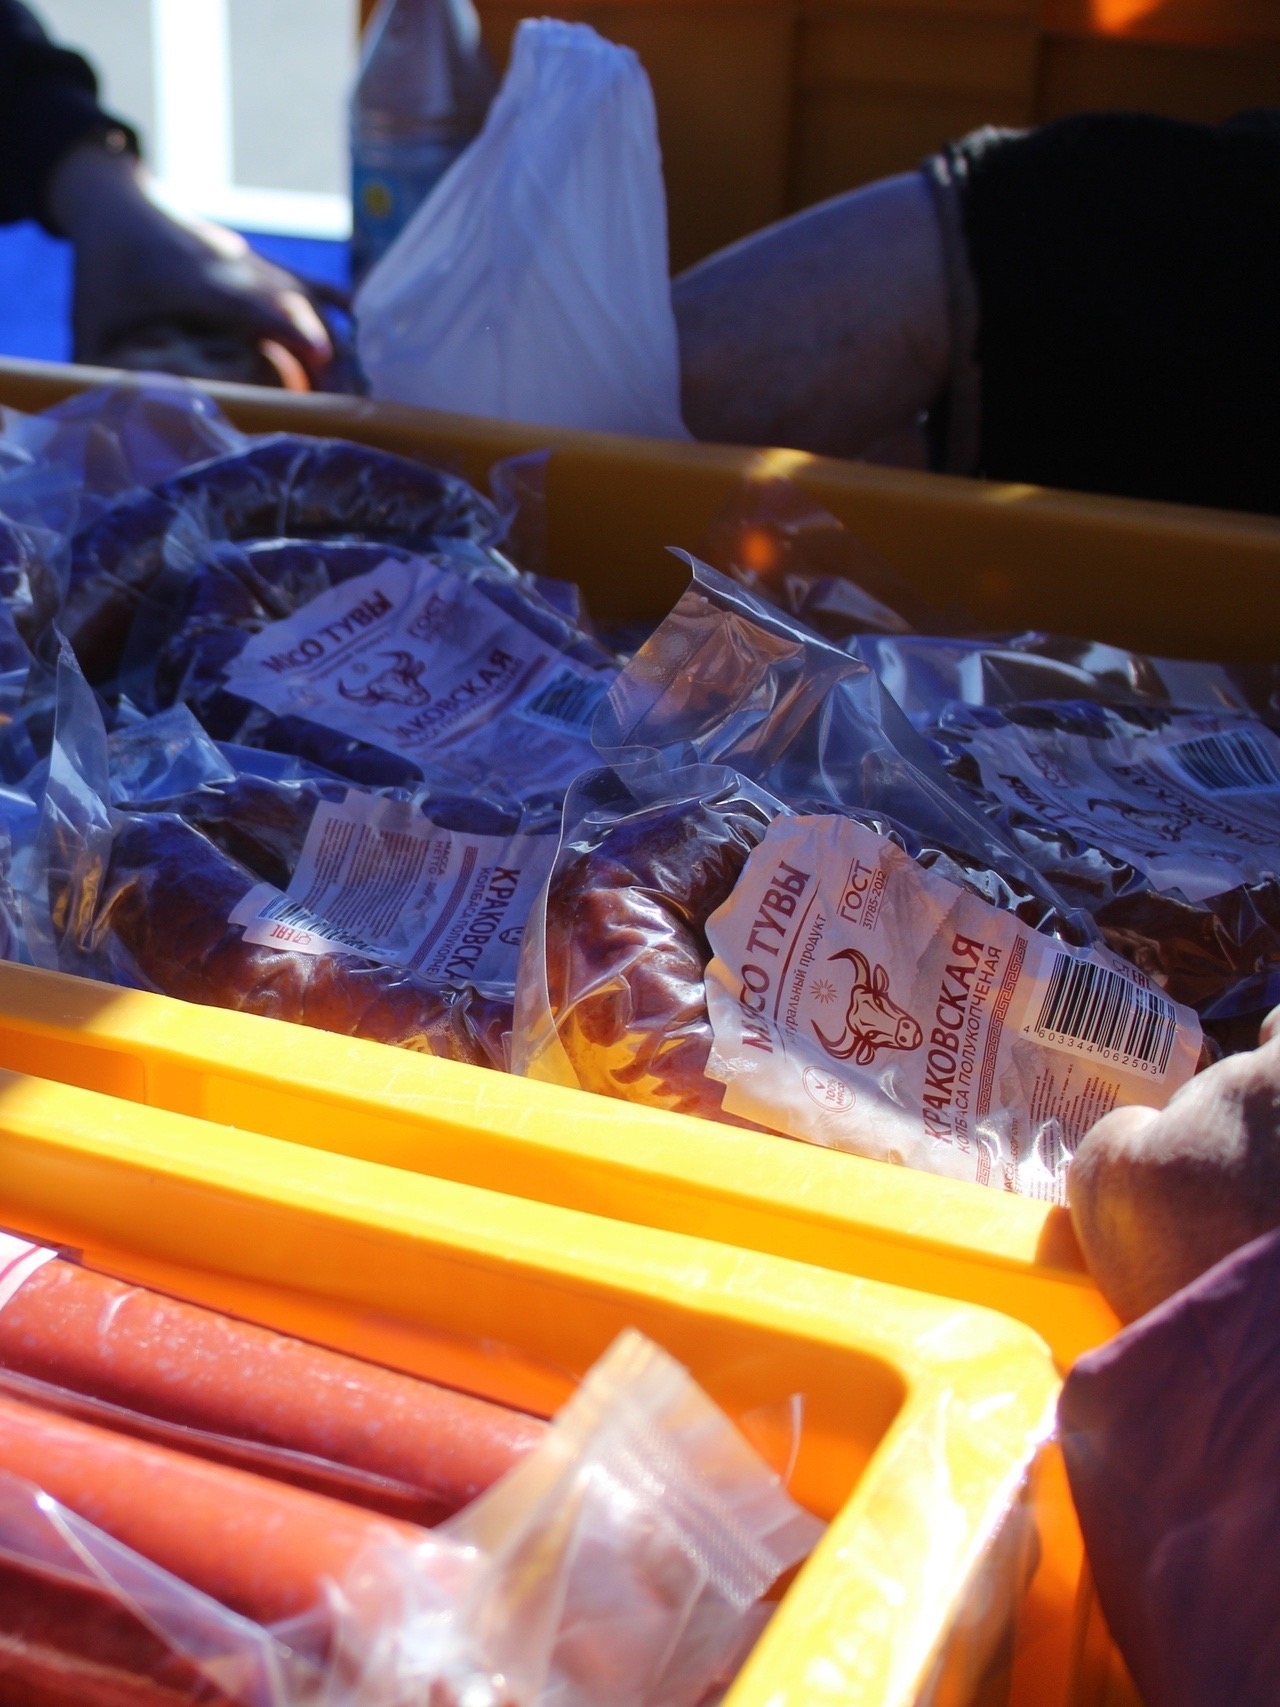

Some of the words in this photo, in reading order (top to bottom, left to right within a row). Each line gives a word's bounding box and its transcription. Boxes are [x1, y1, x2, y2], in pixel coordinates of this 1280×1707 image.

[321, 590, 393, 645] ТУВЫ
[443, 866, 521, 980] КРАКОВСКА
[744, 860, 811, 957] ТУВЫ
[840, 859, 873, 924] ГОСТ
[862, 870, 887, 930] 31785-2012
[426, 919, 469, 975] ПОЛУКОПЧЕ
[785, 969, 807, 1040] туральный
[800, 913, 826, 967] продукт
[924, 933, 984, 1145] КРАКОВСКАЯ
[959, 946, 1002, 1085] ПОЛУКОПЧЕНАЯ
[957, 1088, 972, 1154] КОЛБАСА
